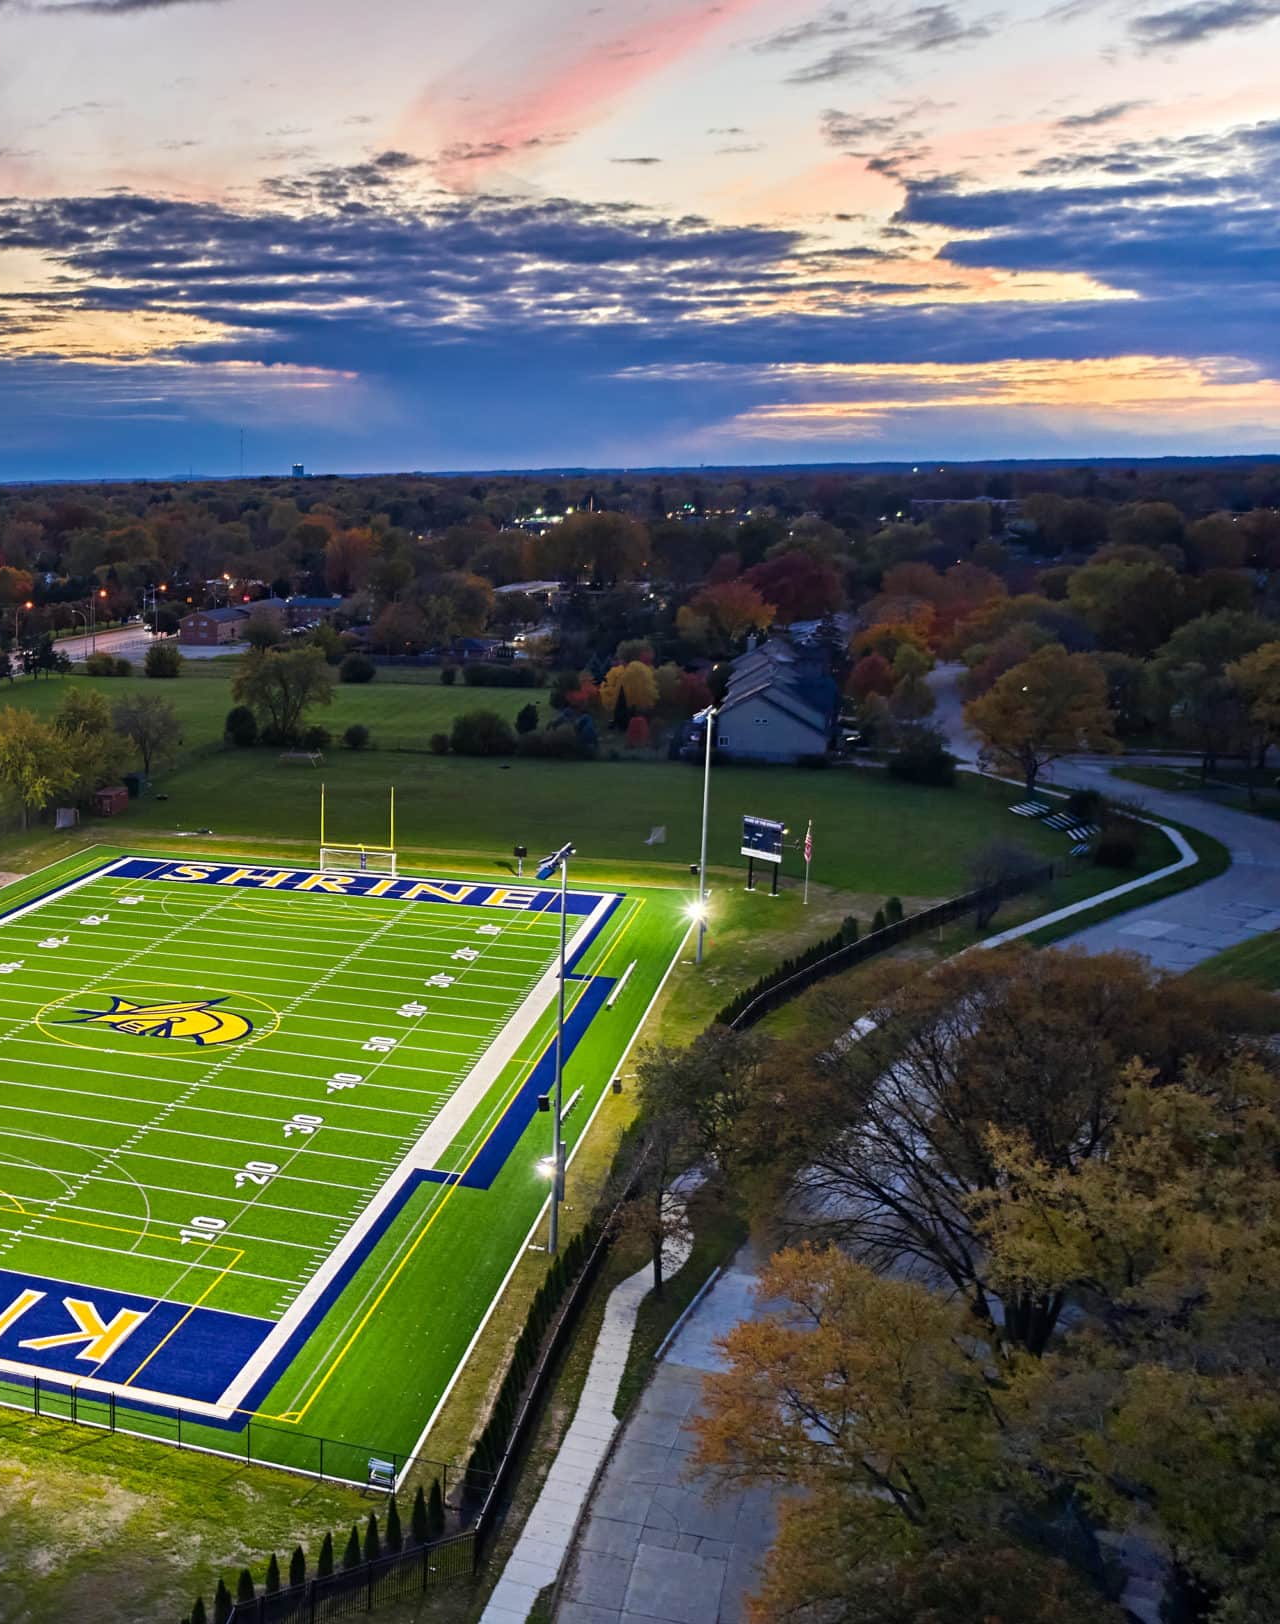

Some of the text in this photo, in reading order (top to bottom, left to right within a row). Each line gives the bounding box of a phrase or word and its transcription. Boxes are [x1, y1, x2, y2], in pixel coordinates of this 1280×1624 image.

[159, 865, 538, 910] SHRINE
[475, 924, 502, 935] 10
[450, 949, 480, 961] 20
[424, 974, 455, 988] 30
[396, 1003, 428, 1017] 40
[361, 1036, 398, 1052] 50
[326, 1072, 363, 1090] 40
[282, 1113, 324, 1134] 30
[234, 1160, 280, 1185] 20
[179, 1215, 228, 1241] 10
